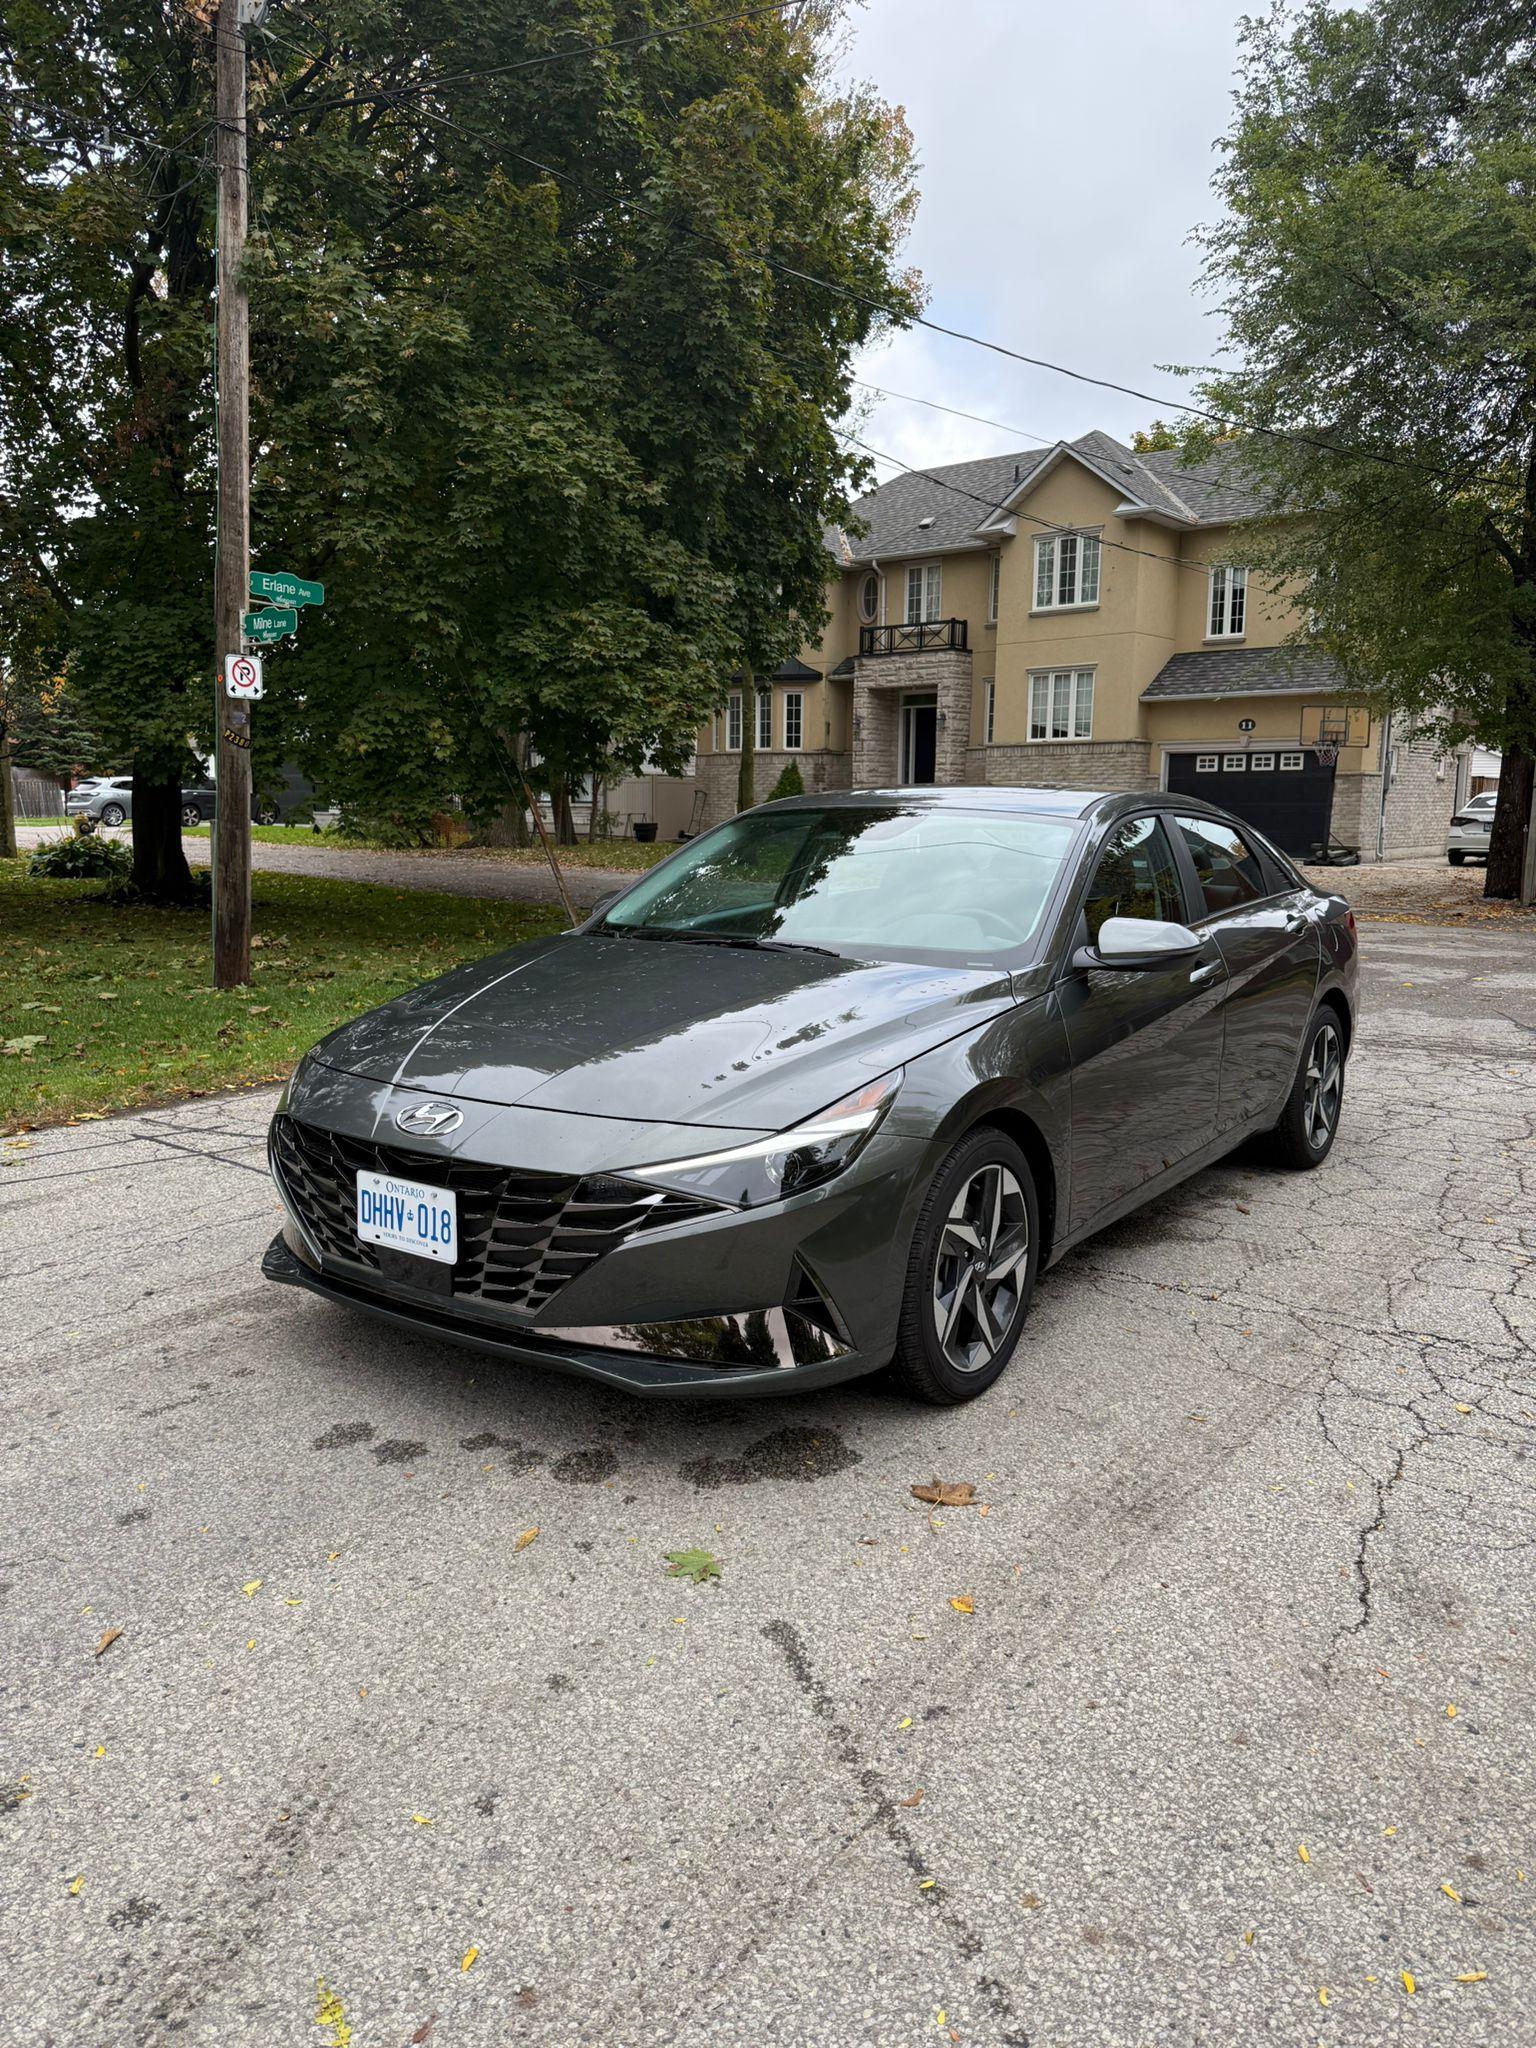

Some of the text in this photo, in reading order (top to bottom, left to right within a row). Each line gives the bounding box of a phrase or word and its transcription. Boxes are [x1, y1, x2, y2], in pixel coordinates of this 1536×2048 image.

[262, 578, 311, 598] Erlane Ave
[253, 617, 287, 630] Milne Lane
[240, 666, 251, 681] P
[241, 714, 247, 723] 2
[1241, 721, 1253, 730] 11
[385, 1180, 425, 1199] ONTARIO
[361, 1189, 452, 1244] DHHV 018
[383, 1232, 398, 1240] YOURS
[406, 1237, 428, 1247] DISCOVER
